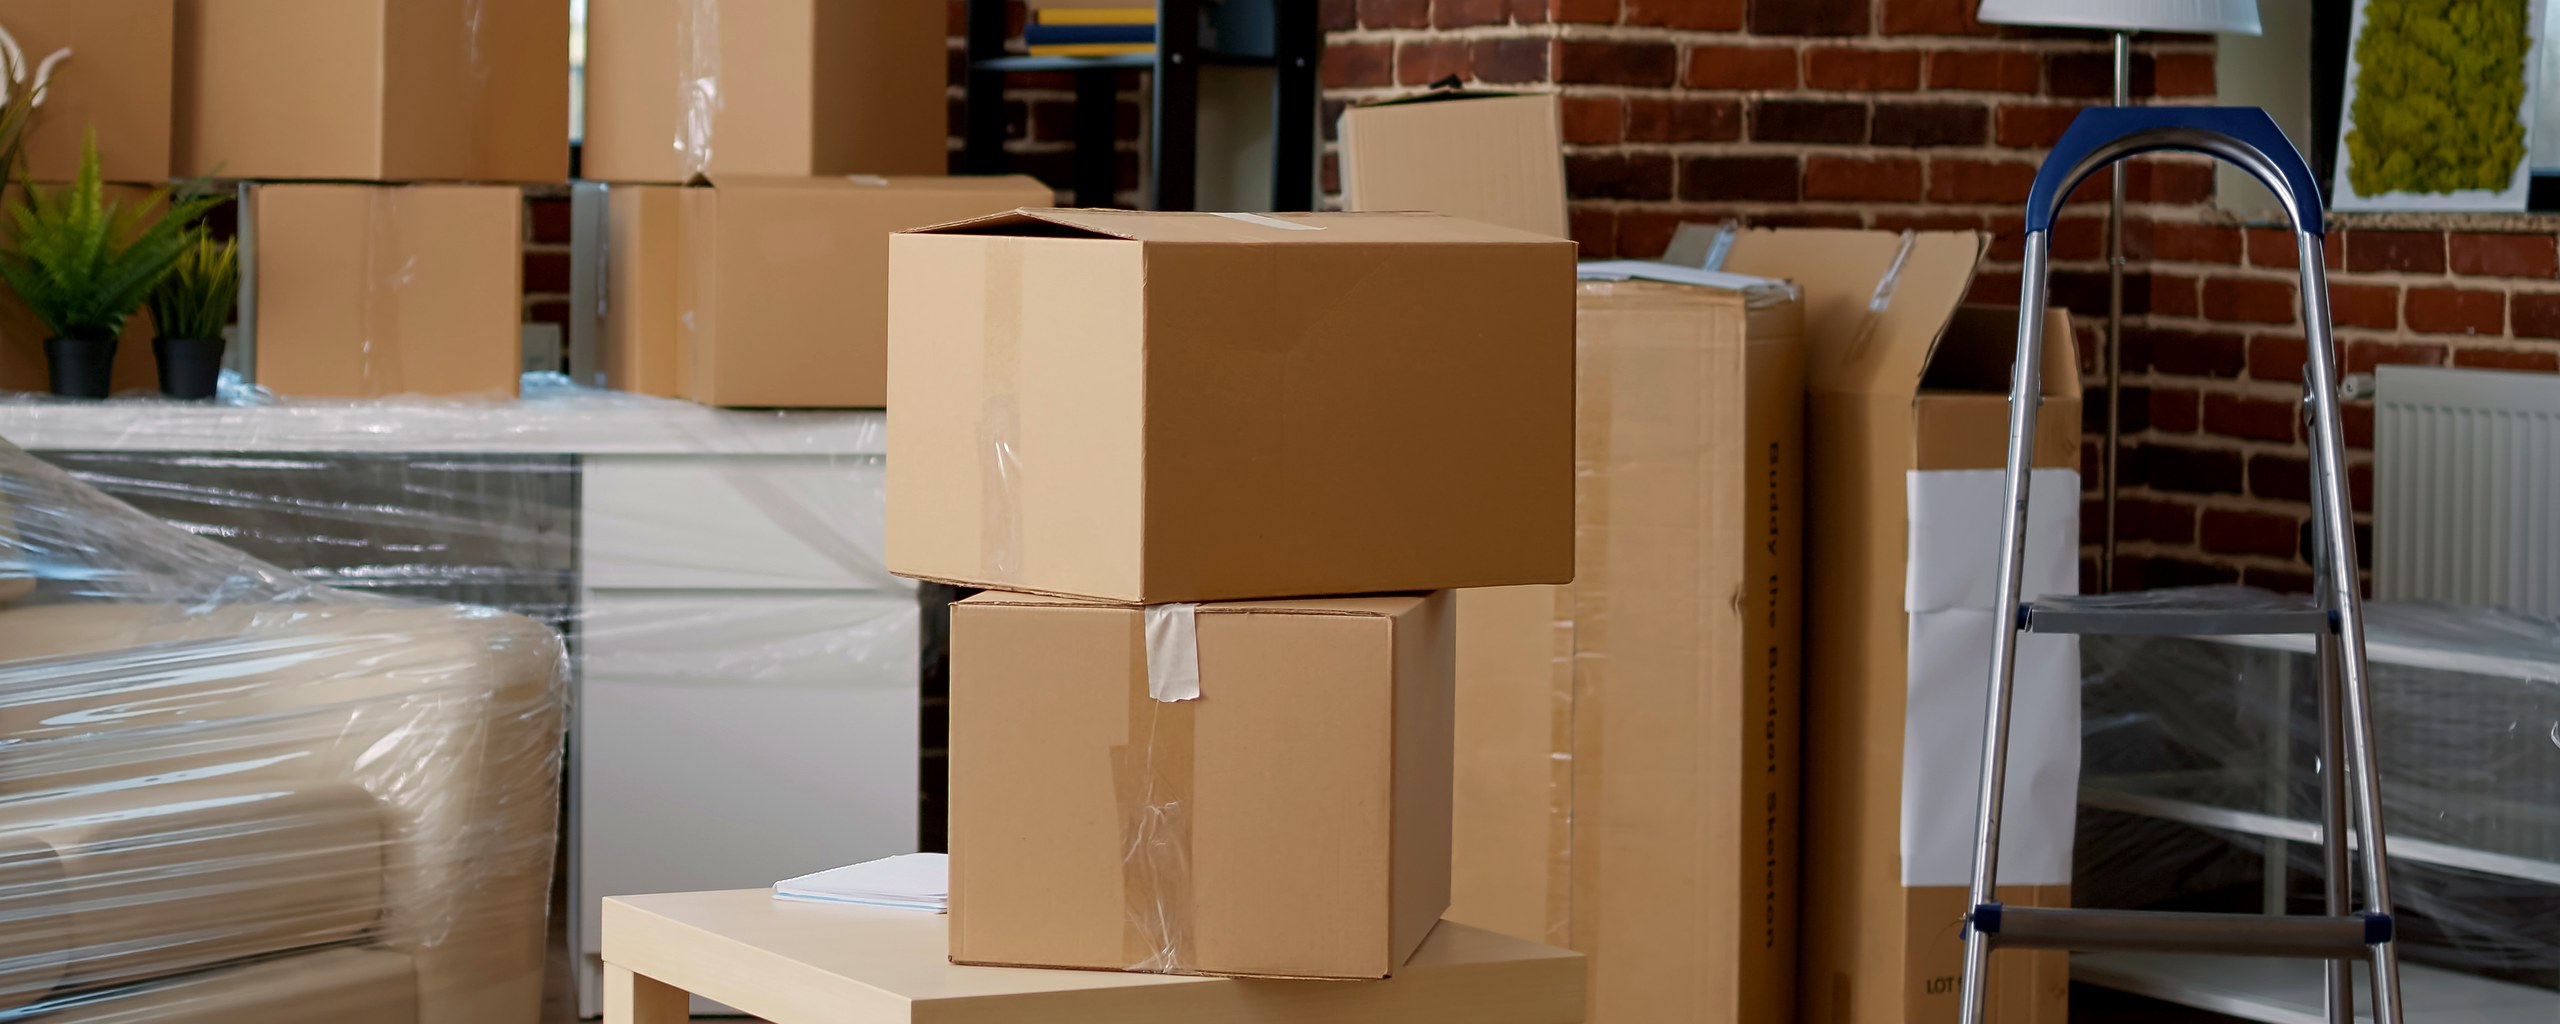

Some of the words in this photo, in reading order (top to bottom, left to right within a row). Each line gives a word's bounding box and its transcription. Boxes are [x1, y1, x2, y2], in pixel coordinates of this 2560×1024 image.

[1767, 441, 1779, 556] Buddy
[1769, 574, 1779, 629] the
[1766, 645, 1778, 774] Budget
[1766, 791, 1777, 949] Skeleton
[1926, 977, 1954, 995] LOT
